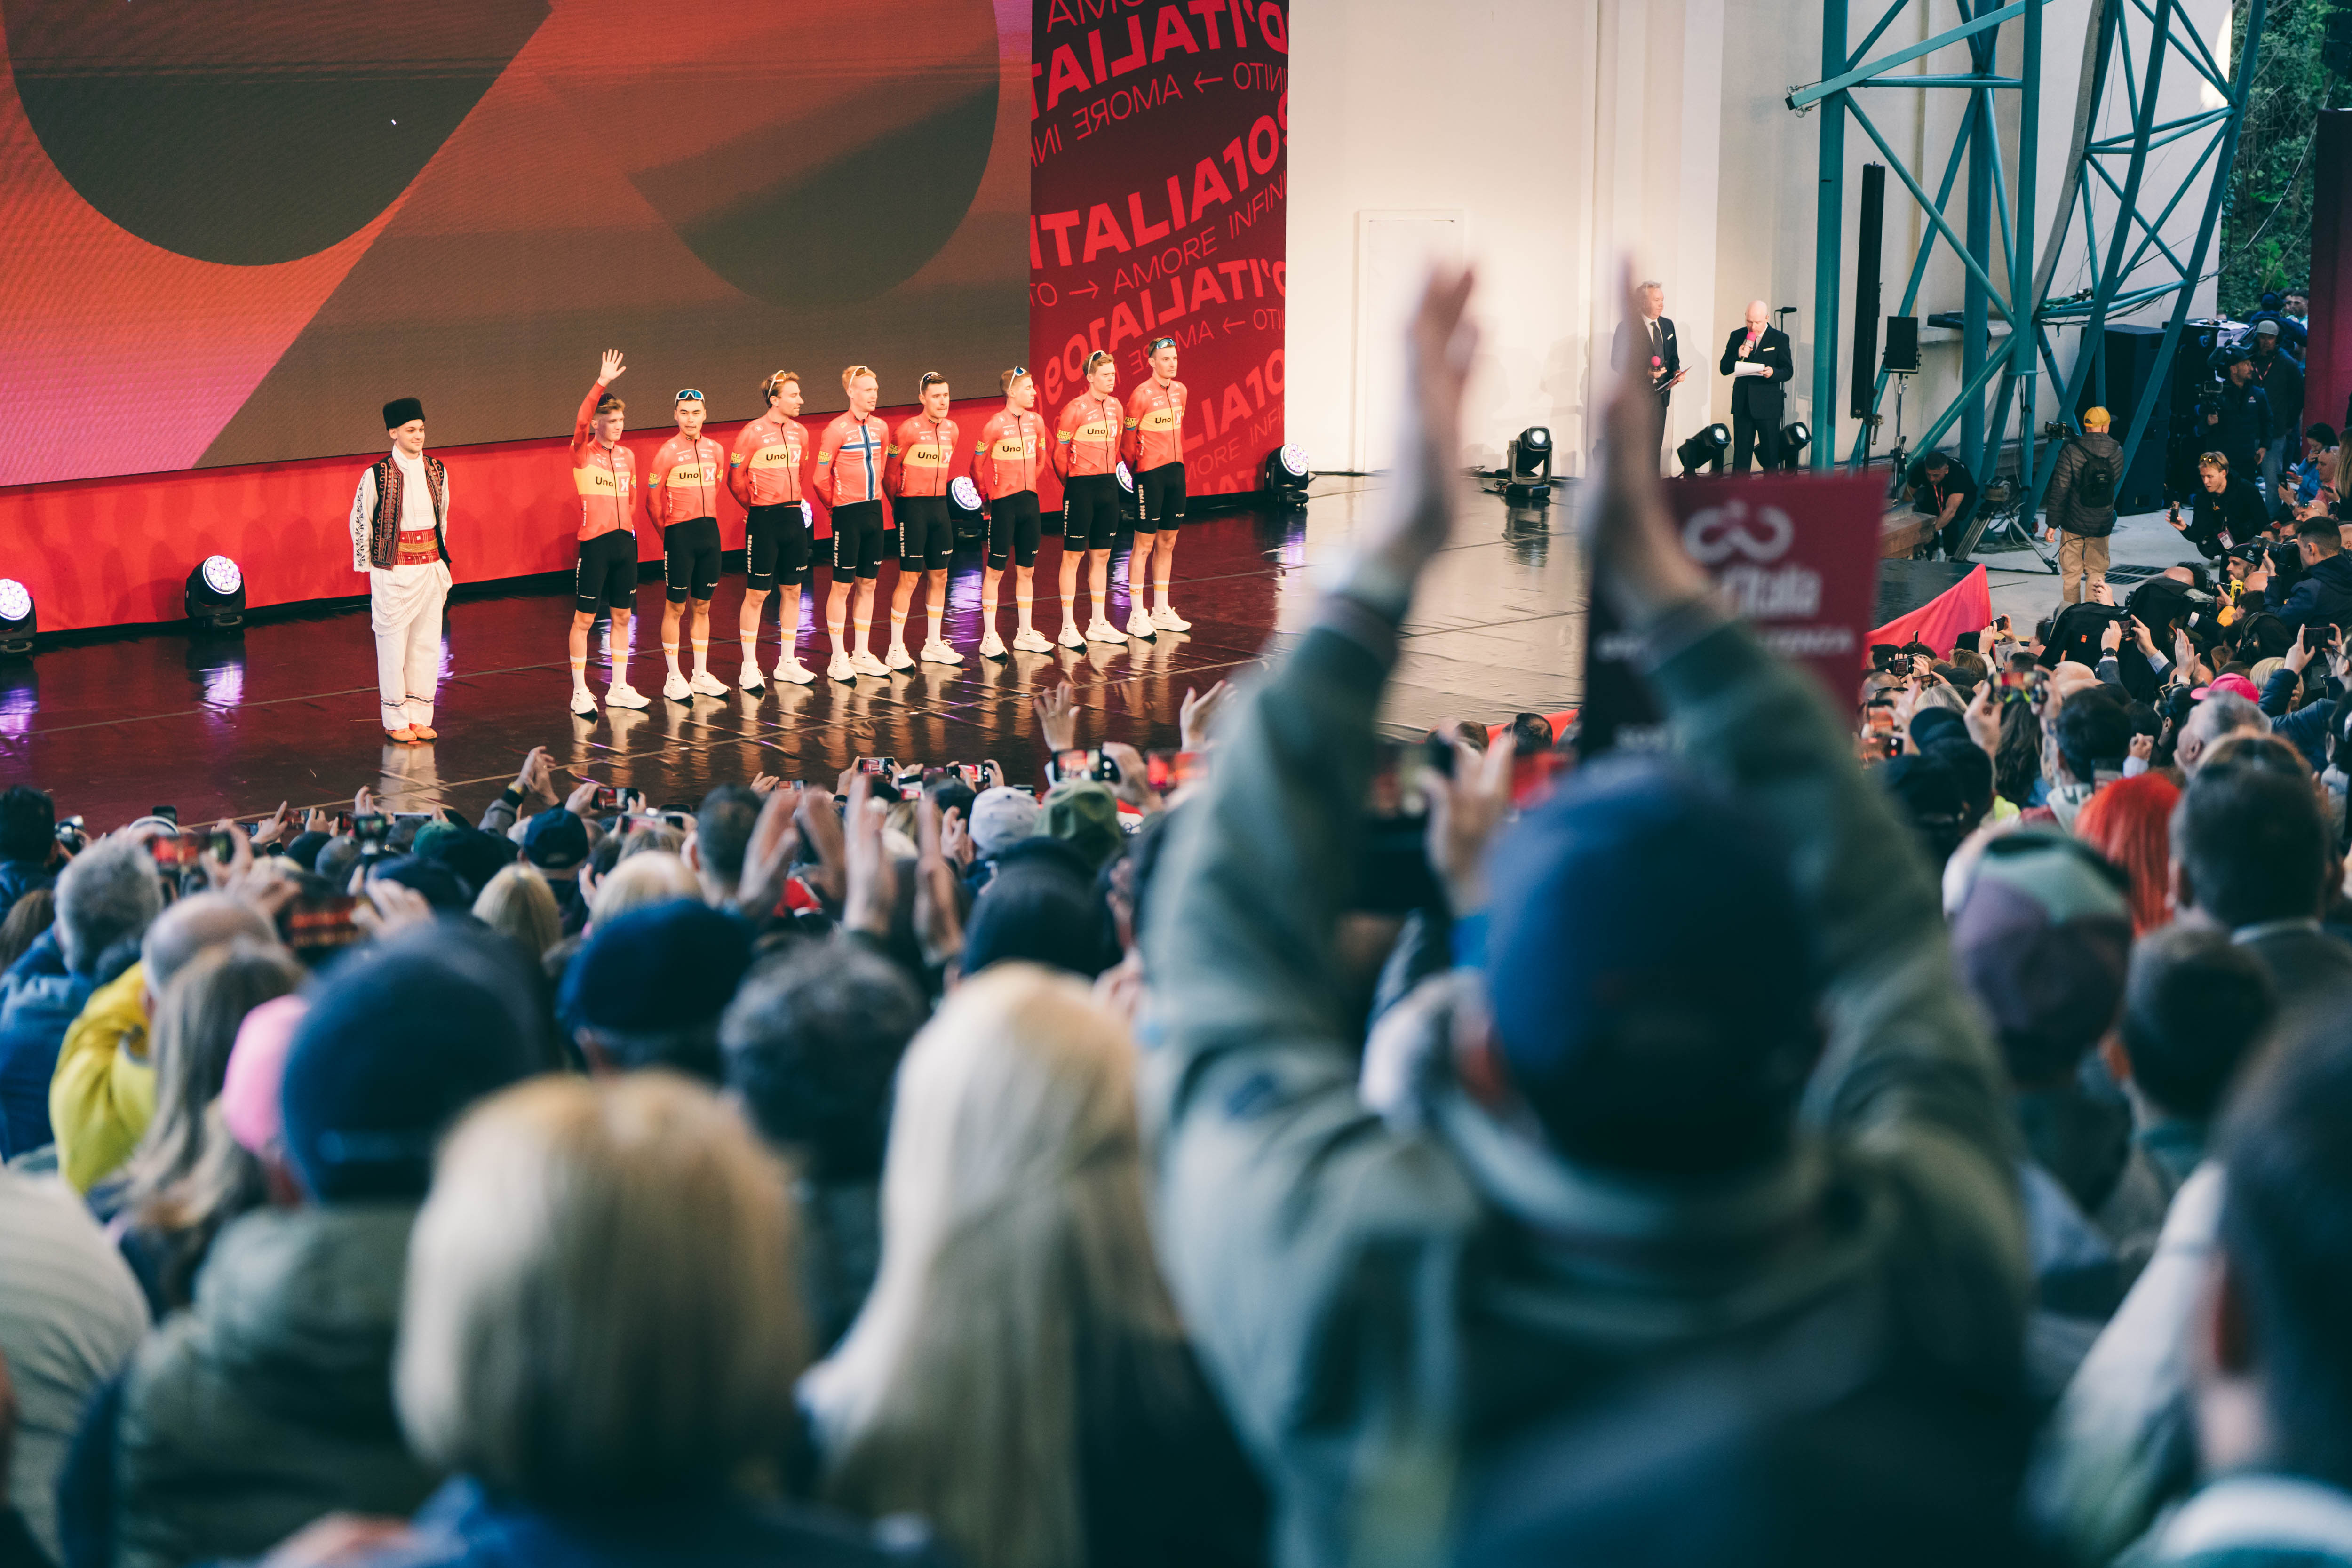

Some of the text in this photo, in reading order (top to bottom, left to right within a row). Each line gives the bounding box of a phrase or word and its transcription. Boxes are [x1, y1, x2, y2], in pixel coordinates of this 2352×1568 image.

[1047, 0, 1144, 33] AM
[1113, 226, 1217, 294] AMORE
[596, 476, 613, 487] Uno
